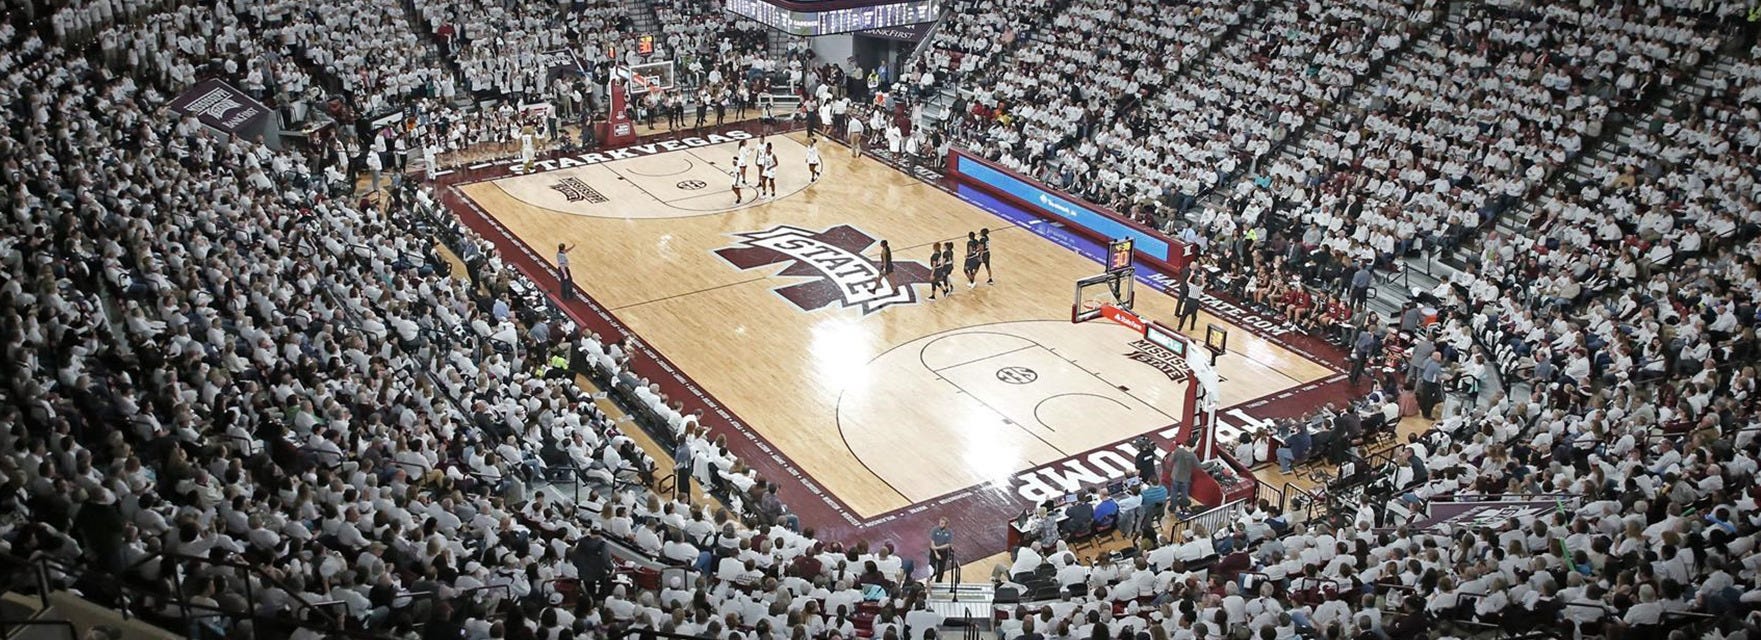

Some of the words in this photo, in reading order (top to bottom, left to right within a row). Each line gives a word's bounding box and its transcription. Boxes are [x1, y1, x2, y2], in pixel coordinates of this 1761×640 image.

[509, 130, 752, 174] STARKVEGAS
[773, 238, 884, 295] STATE
[1111, 251, 1129, 268] 30
[1137, 355, 1180, 381] STATE
